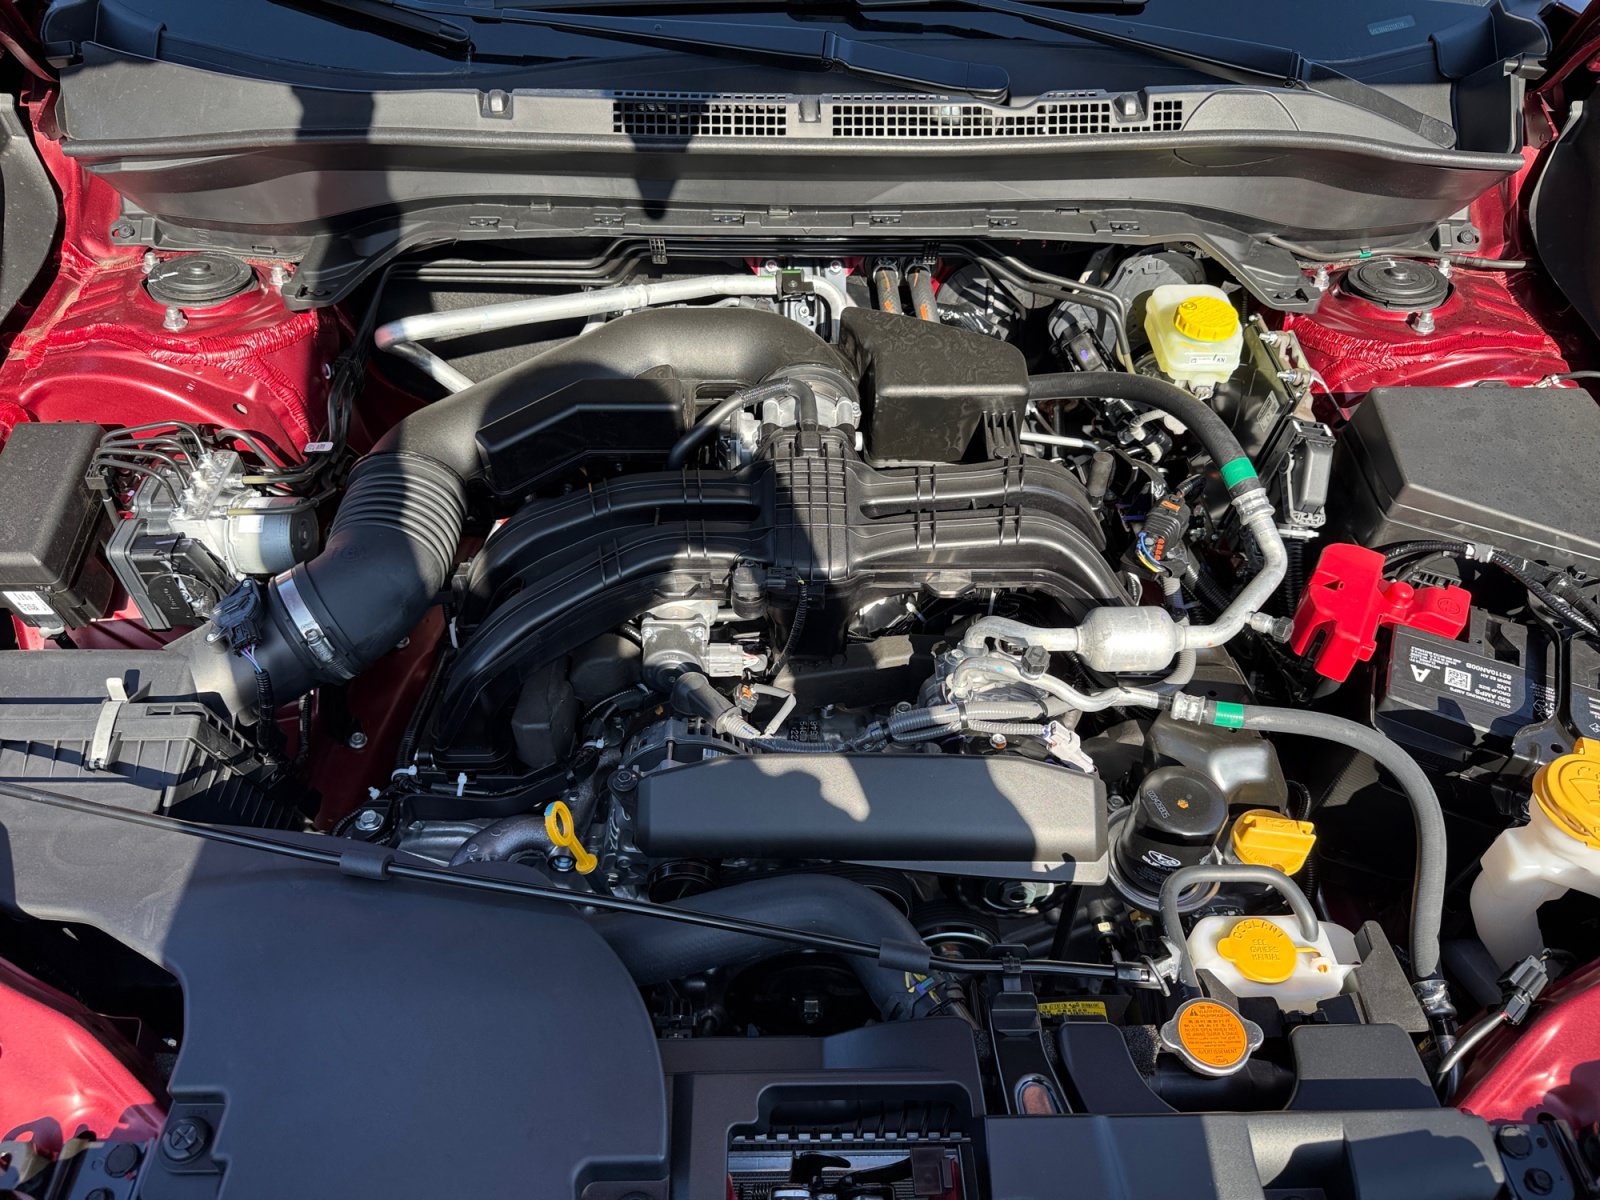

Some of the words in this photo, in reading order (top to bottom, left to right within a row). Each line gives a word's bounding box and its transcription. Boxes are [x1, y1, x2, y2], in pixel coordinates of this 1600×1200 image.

[1449, 687, 1465, 695] AMPS
[1491, 687, 1511, 697] GROUP
[1496, 683, 1512, 692] LN2
[1465, 691, 1494, 704] CRANKING
[1474, 688, 1497, 700] AMPS
[1497, 695, 1511, 704] 620
[1494, 700, 1511, 709] COLD
[1233, 920, 1285, 939] COOLANT
